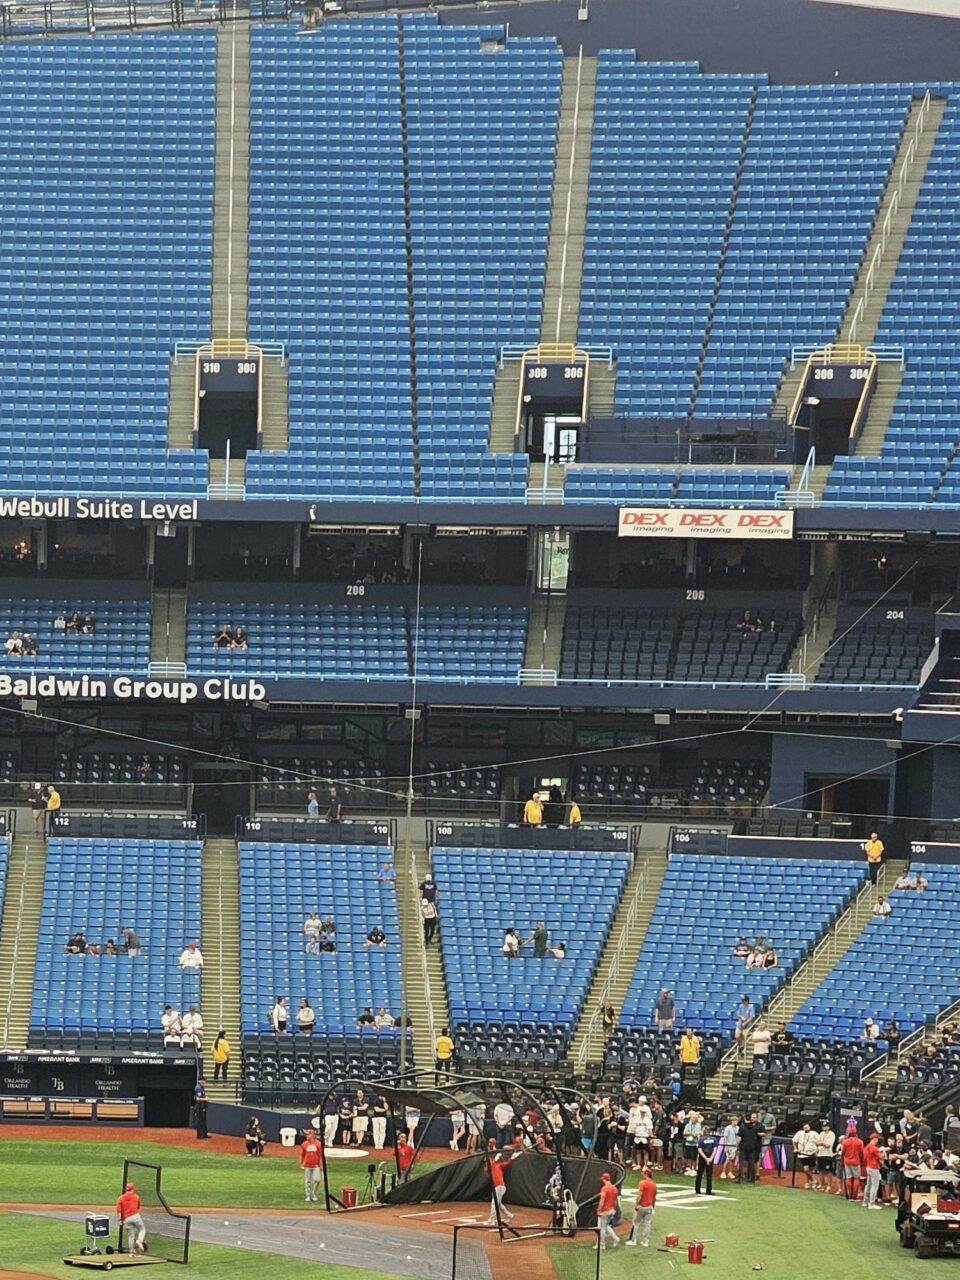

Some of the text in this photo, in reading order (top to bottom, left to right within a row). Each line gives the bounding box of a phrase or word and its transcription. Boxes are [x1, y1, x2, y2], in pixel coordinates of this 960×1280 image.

[203, 363, 221, 374] 310
[564, 367, 583, 379] 306
[850, 368, 869, 380] 304
[814, 369, 834, 380] 306
[76, 499, 134, 519] Suite
[140, 500, 197, 519] Level
[622, 513, 670, 526] DEX
[679, 514, 728, 527] DEX
[737, 514, 786, 527] DEX
[346, 585, 365, 596] 208
[686, 590, 705, 601] 206
[887, 610, 904, 620] 204
[113, 677, 198, 703] Group
[203, 679, 266, 701] Club
[54, 818, 70, 826] 112
[182, 820, 197, 828] 112
[245, 822, 261, 831] 110
[373, 826, 388, 834] 110
[437, 827, 452, 835] 108
[612, 832, 628, 840] 108
[675, 834, 690, 842] 106
[911, 845, 926, 853] 104
[51, 1078, 64, 1091] TB
